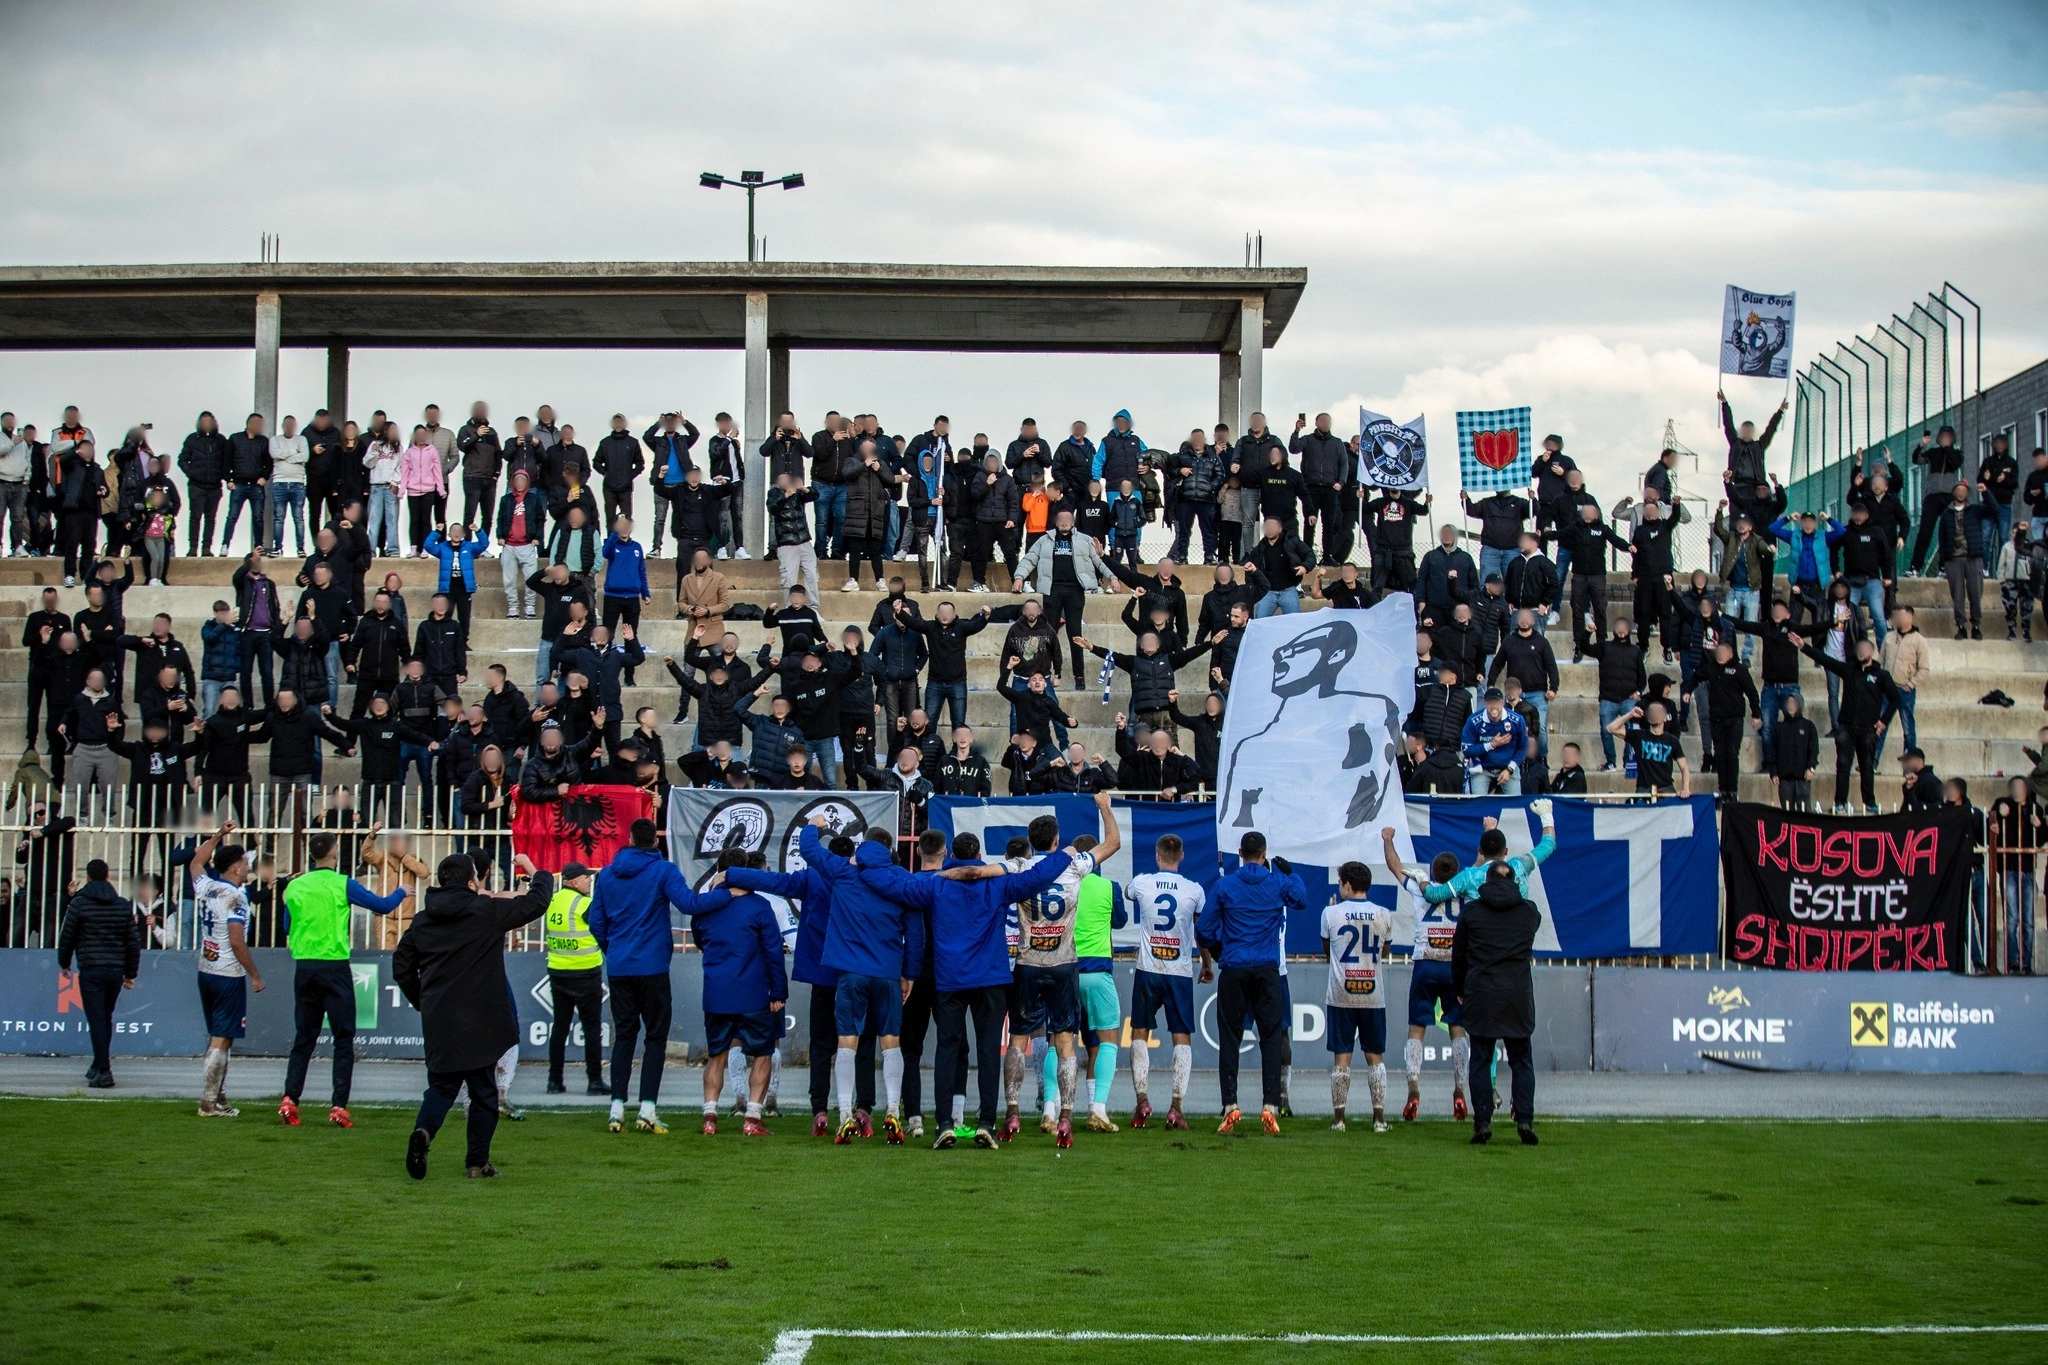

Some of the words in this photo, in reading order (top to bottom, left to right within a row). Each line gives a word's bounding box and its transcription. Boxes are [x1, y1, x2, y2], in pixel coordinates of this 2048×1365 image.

[1741, 292, 1764, 304] Blue
[1767, 295, 1793, 308] Boys
[1641, 740, 1673, 762] 1987
[1757, 819, 1939, 878] KOSOVA
[1156, 881, 1178, 890] VITIJA
[1030, 882, 1066, 922] 16
[1789, 877, 1908, 922] ËSHTË
[550, 912, 563, 926] 43
[1153, 893, 1178, 932] 3
[1345, 912, 1375, 921] SALETIC
[1337, 924, 1380, 964] 24
[1733, 913, 1949, 972] SHQIPËRI
[1346, 981, 1374, 990] RIO
[1892, 1001, 1995, 1024] Raiffeisen
[3, 1020, 65, 1033] TRION
[78, 1021, 154, 1034] IEST
[1672, 1017, 1786, 1043] MOKNE
[1893, 1027, 1958, 1049] BANK
[368, 1036, 392, 1045] JOINT
[1734, 1050, 1762, 1060] WATER
